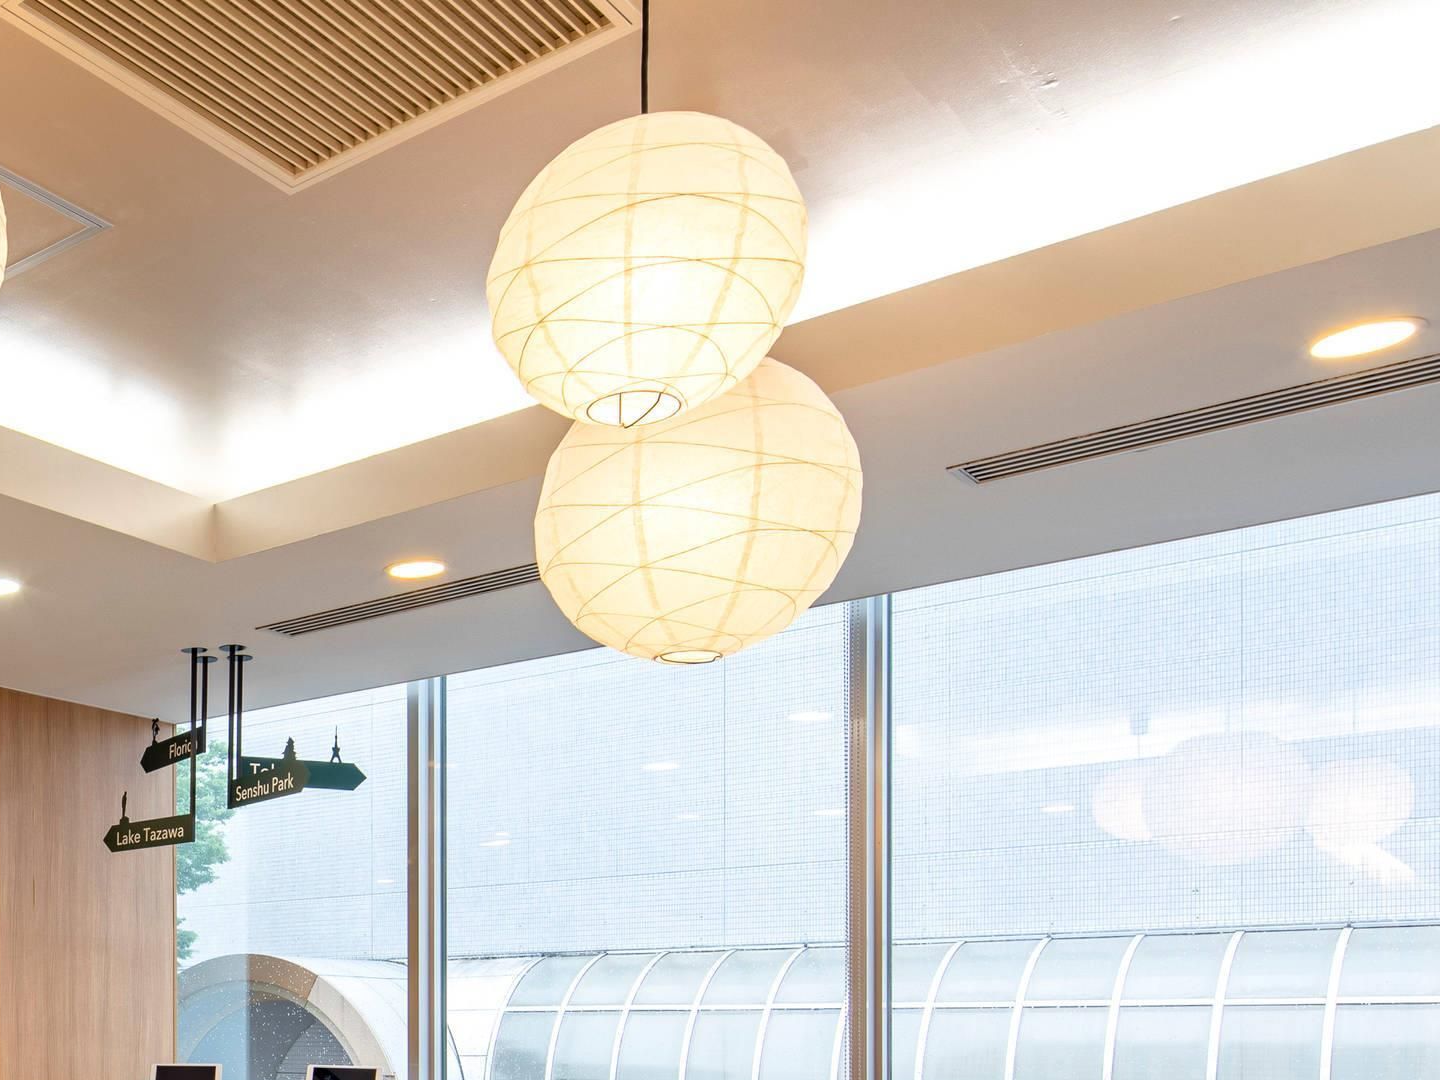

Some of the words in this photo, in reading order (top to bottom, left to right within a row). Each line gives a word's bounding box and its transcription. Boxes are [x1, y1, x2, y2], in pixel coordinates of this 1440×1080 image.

[169, 738, 198, 759] Flori
[235, 779, 269, 802] Senshu
[271, 772, 294, 793] Park
[116, 826, 141, 846] Lake
[144, 824, 184, 842] Tazawa
